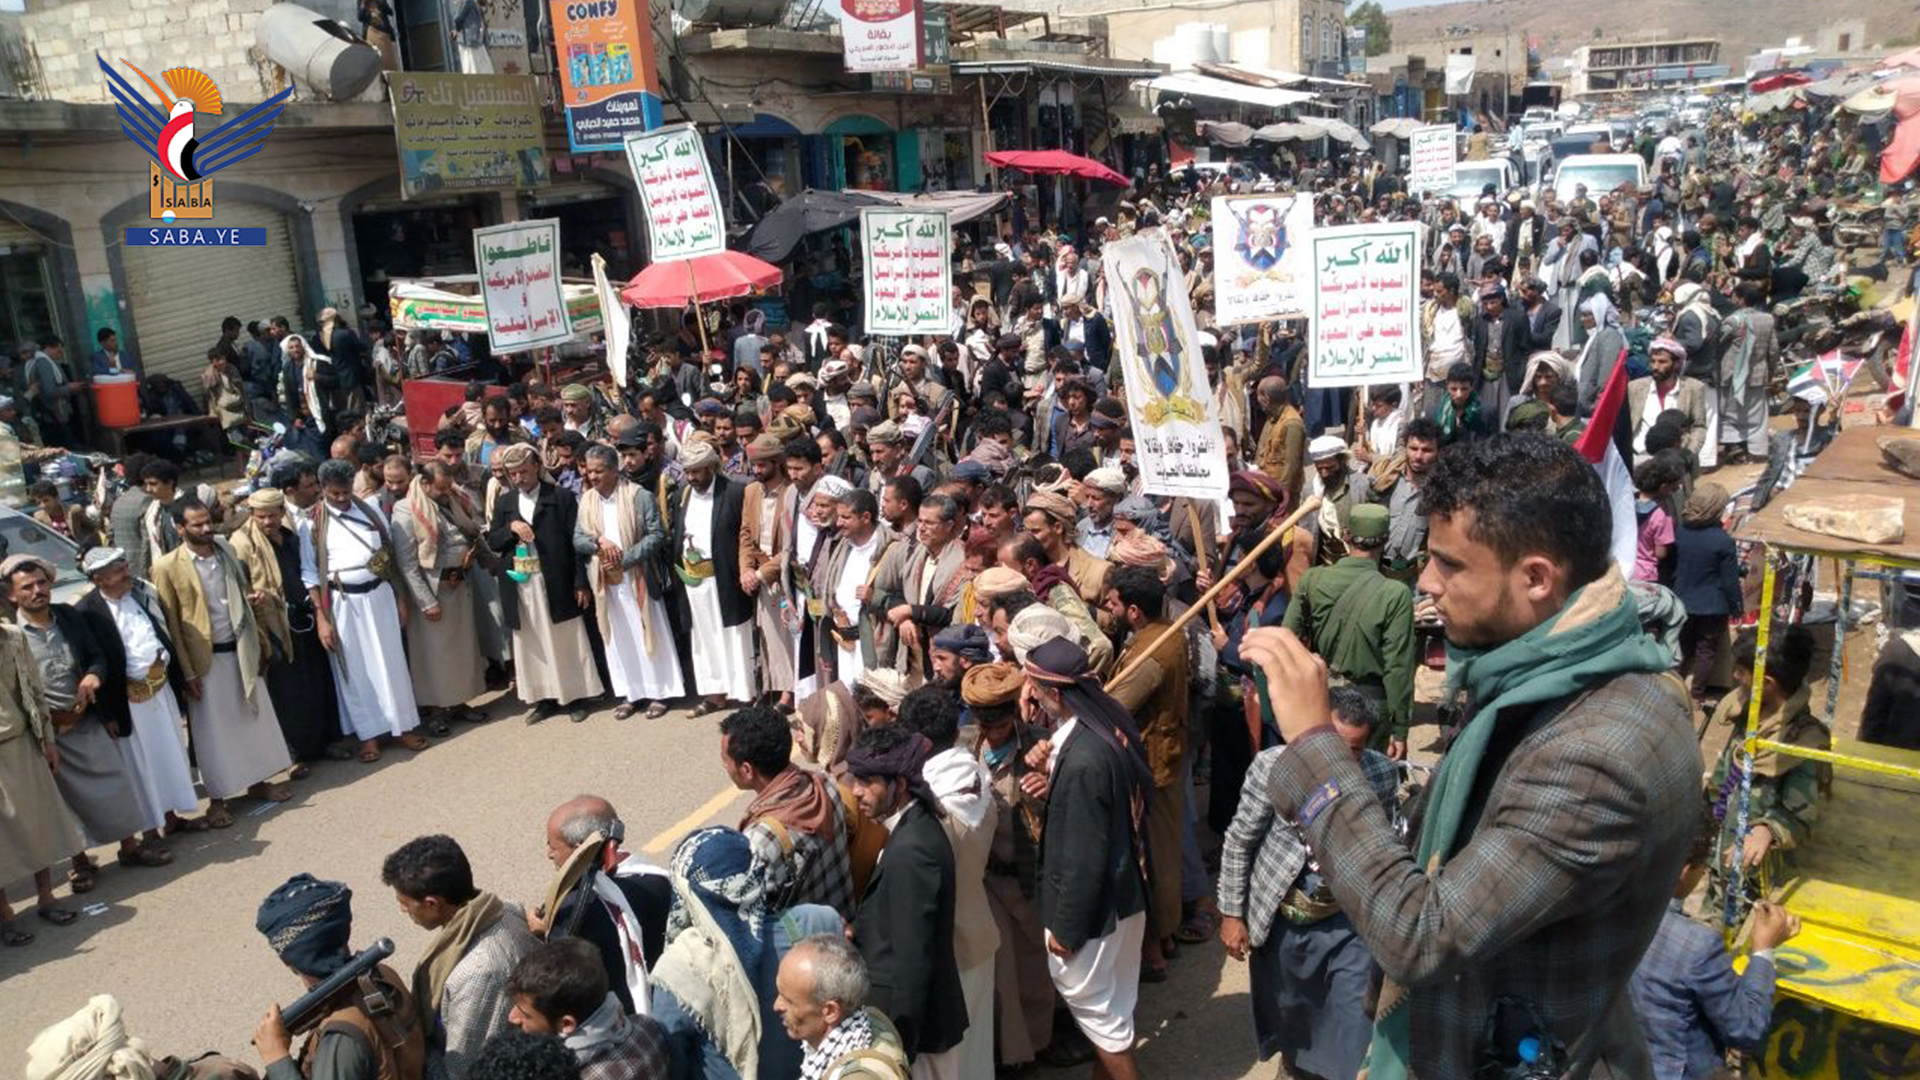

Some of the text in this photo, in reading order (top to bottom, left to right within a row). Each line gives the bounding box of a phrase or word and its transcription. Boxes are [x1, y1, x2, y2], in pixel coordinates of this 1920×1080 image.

[460, 81, 537, 110] المستقبل
[606, 99, 638, 113] تموينات
[620, 117, 641, 126] محمد
[640, 135, 697, 170] الله أكبر
[676, 162, 702, 180] الموت
[680, 182, 709, 201] الموت
[690, 222, 717, 247] النصر
[872, 216, 943, 243] الله أكبر
[911, 246, 943, 261] الموت
[1321, 240, 1410, 274] الله أكبر
[912, 266, 944, 281] الموت
[1370, 274, 1408, 292] الموت
[522, 292, 528, 307] و
[1370, 298, 1408, 316] الموت
[912, 303, 944, 325] النصر
[1321, 322, 1408, 343] اللعنة على اليهود
[1369, 343, 1409, 368] النصر
